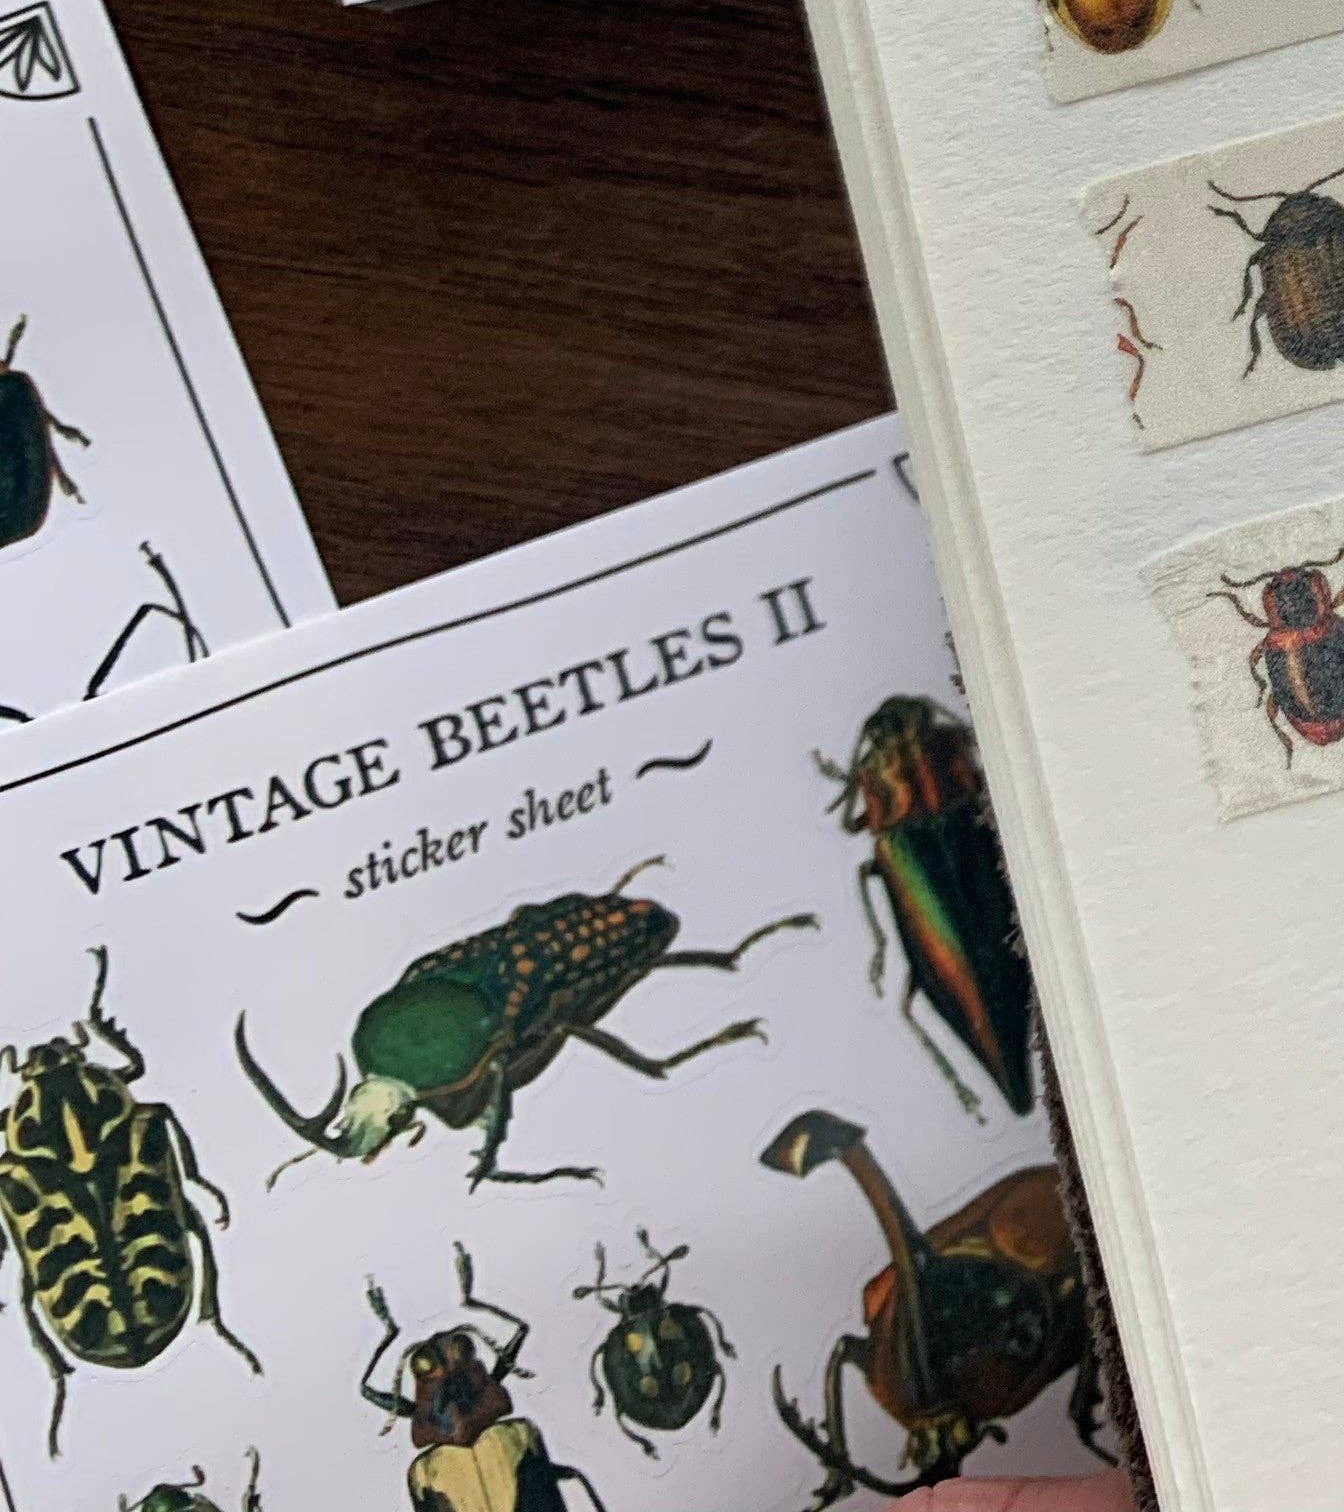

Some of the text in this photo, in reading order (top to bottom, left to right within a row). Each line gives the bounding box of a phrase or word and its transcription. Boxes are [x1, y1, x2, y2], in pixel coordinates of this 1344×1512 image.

[60, 577, 826, 896] VINTAGE BEETLES II
[343, 767, 613, 900] sticker sheet
